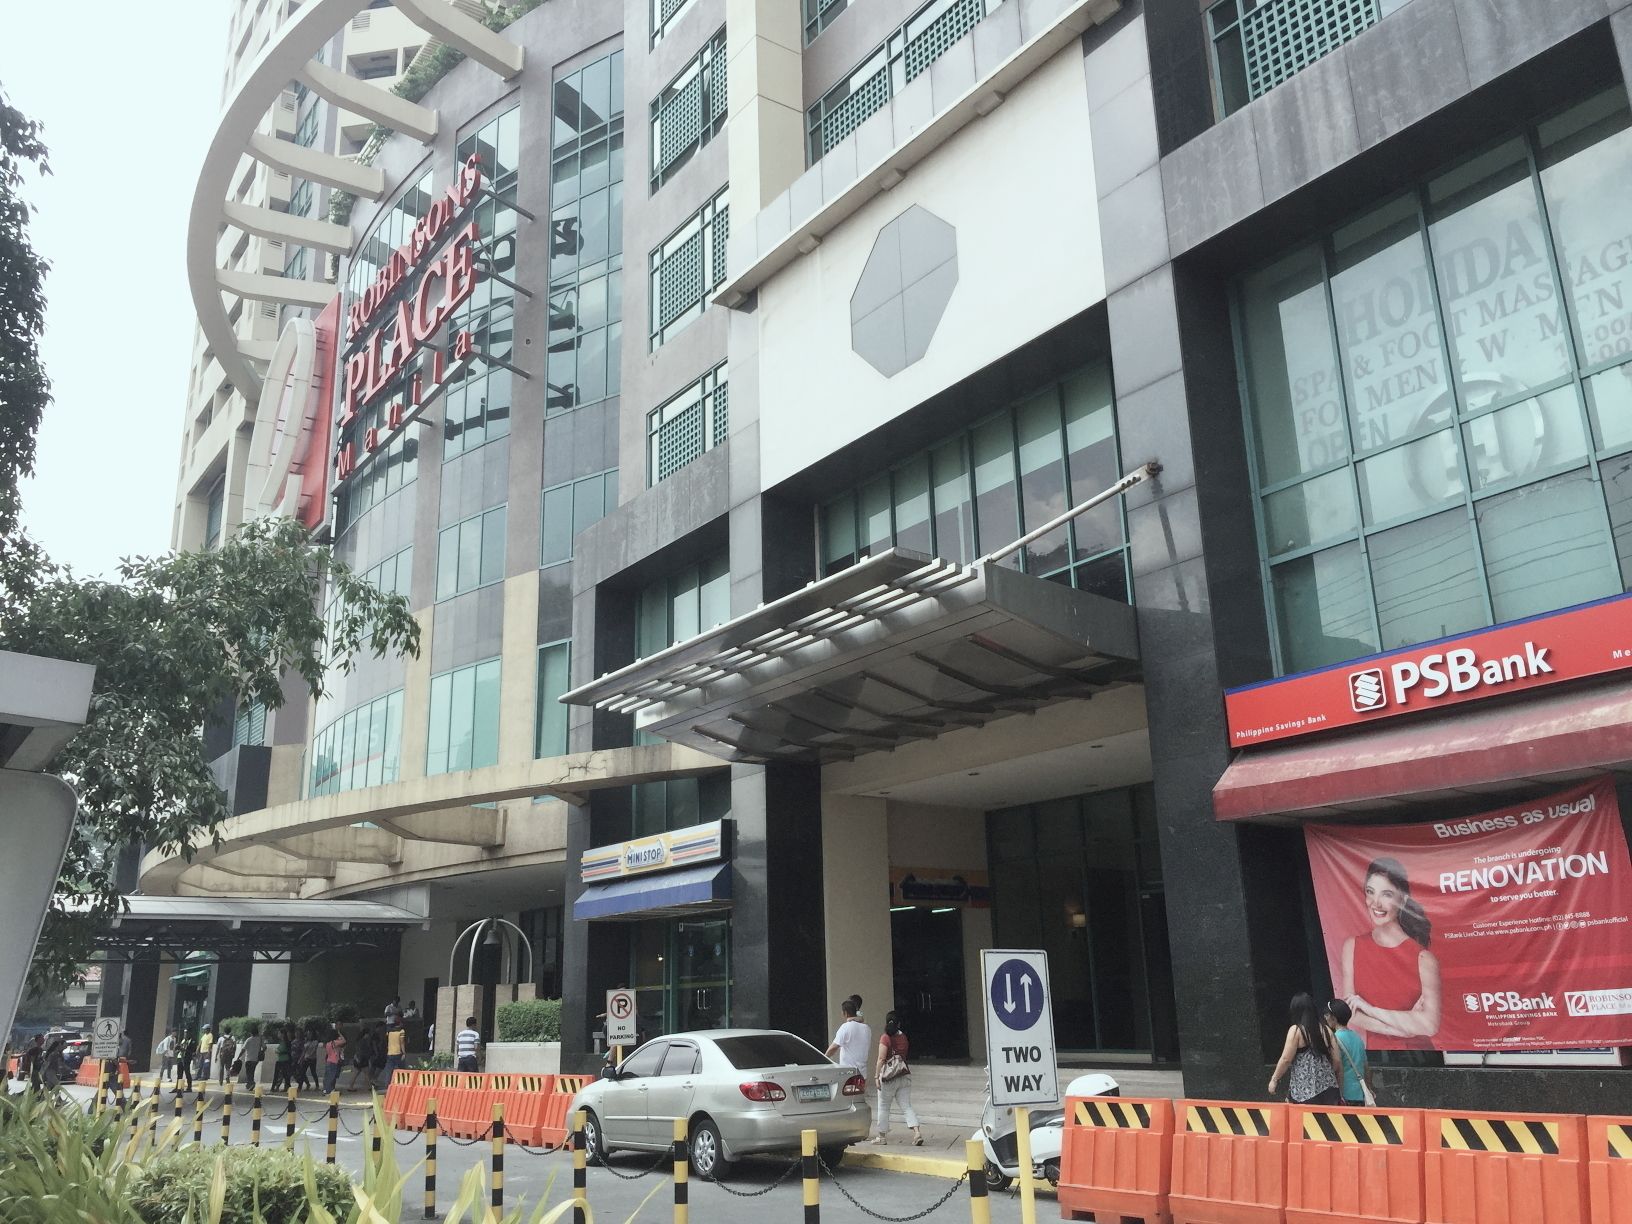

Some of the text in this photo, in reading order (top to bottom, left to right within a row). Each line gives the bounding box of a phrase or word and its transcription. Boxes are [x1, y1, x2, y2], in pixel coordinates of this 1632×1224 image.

[349, 153, 482, 341] ROBINSONS
[341, 222, 480, 426] PLACE
[338, 331, 472, 480] Manila
[1391, 642, 1553, 703] PSBank
[1236, 714, 1326, 739] Philippine Savings Bank
[1433, 794, 1596, 839] Business as usual
[1474, 856, 1487, 865] The
[1487, 853, 1510, 864] branch
[1518, 846, 1562, 858] undergoing
[1439, 851, 1609, 894] RENOVATION
[1490, 889, 1559, 903] to serve you better.
[1472, 921, 1498, 930] Customer
[1498, 918, 1529, 928] Experience
[1481, 991, 1556, 1012] PSBank
[1002, 1046, 1042, 1063] TWO
[1004, 1074, 1043, 1093] WAY
